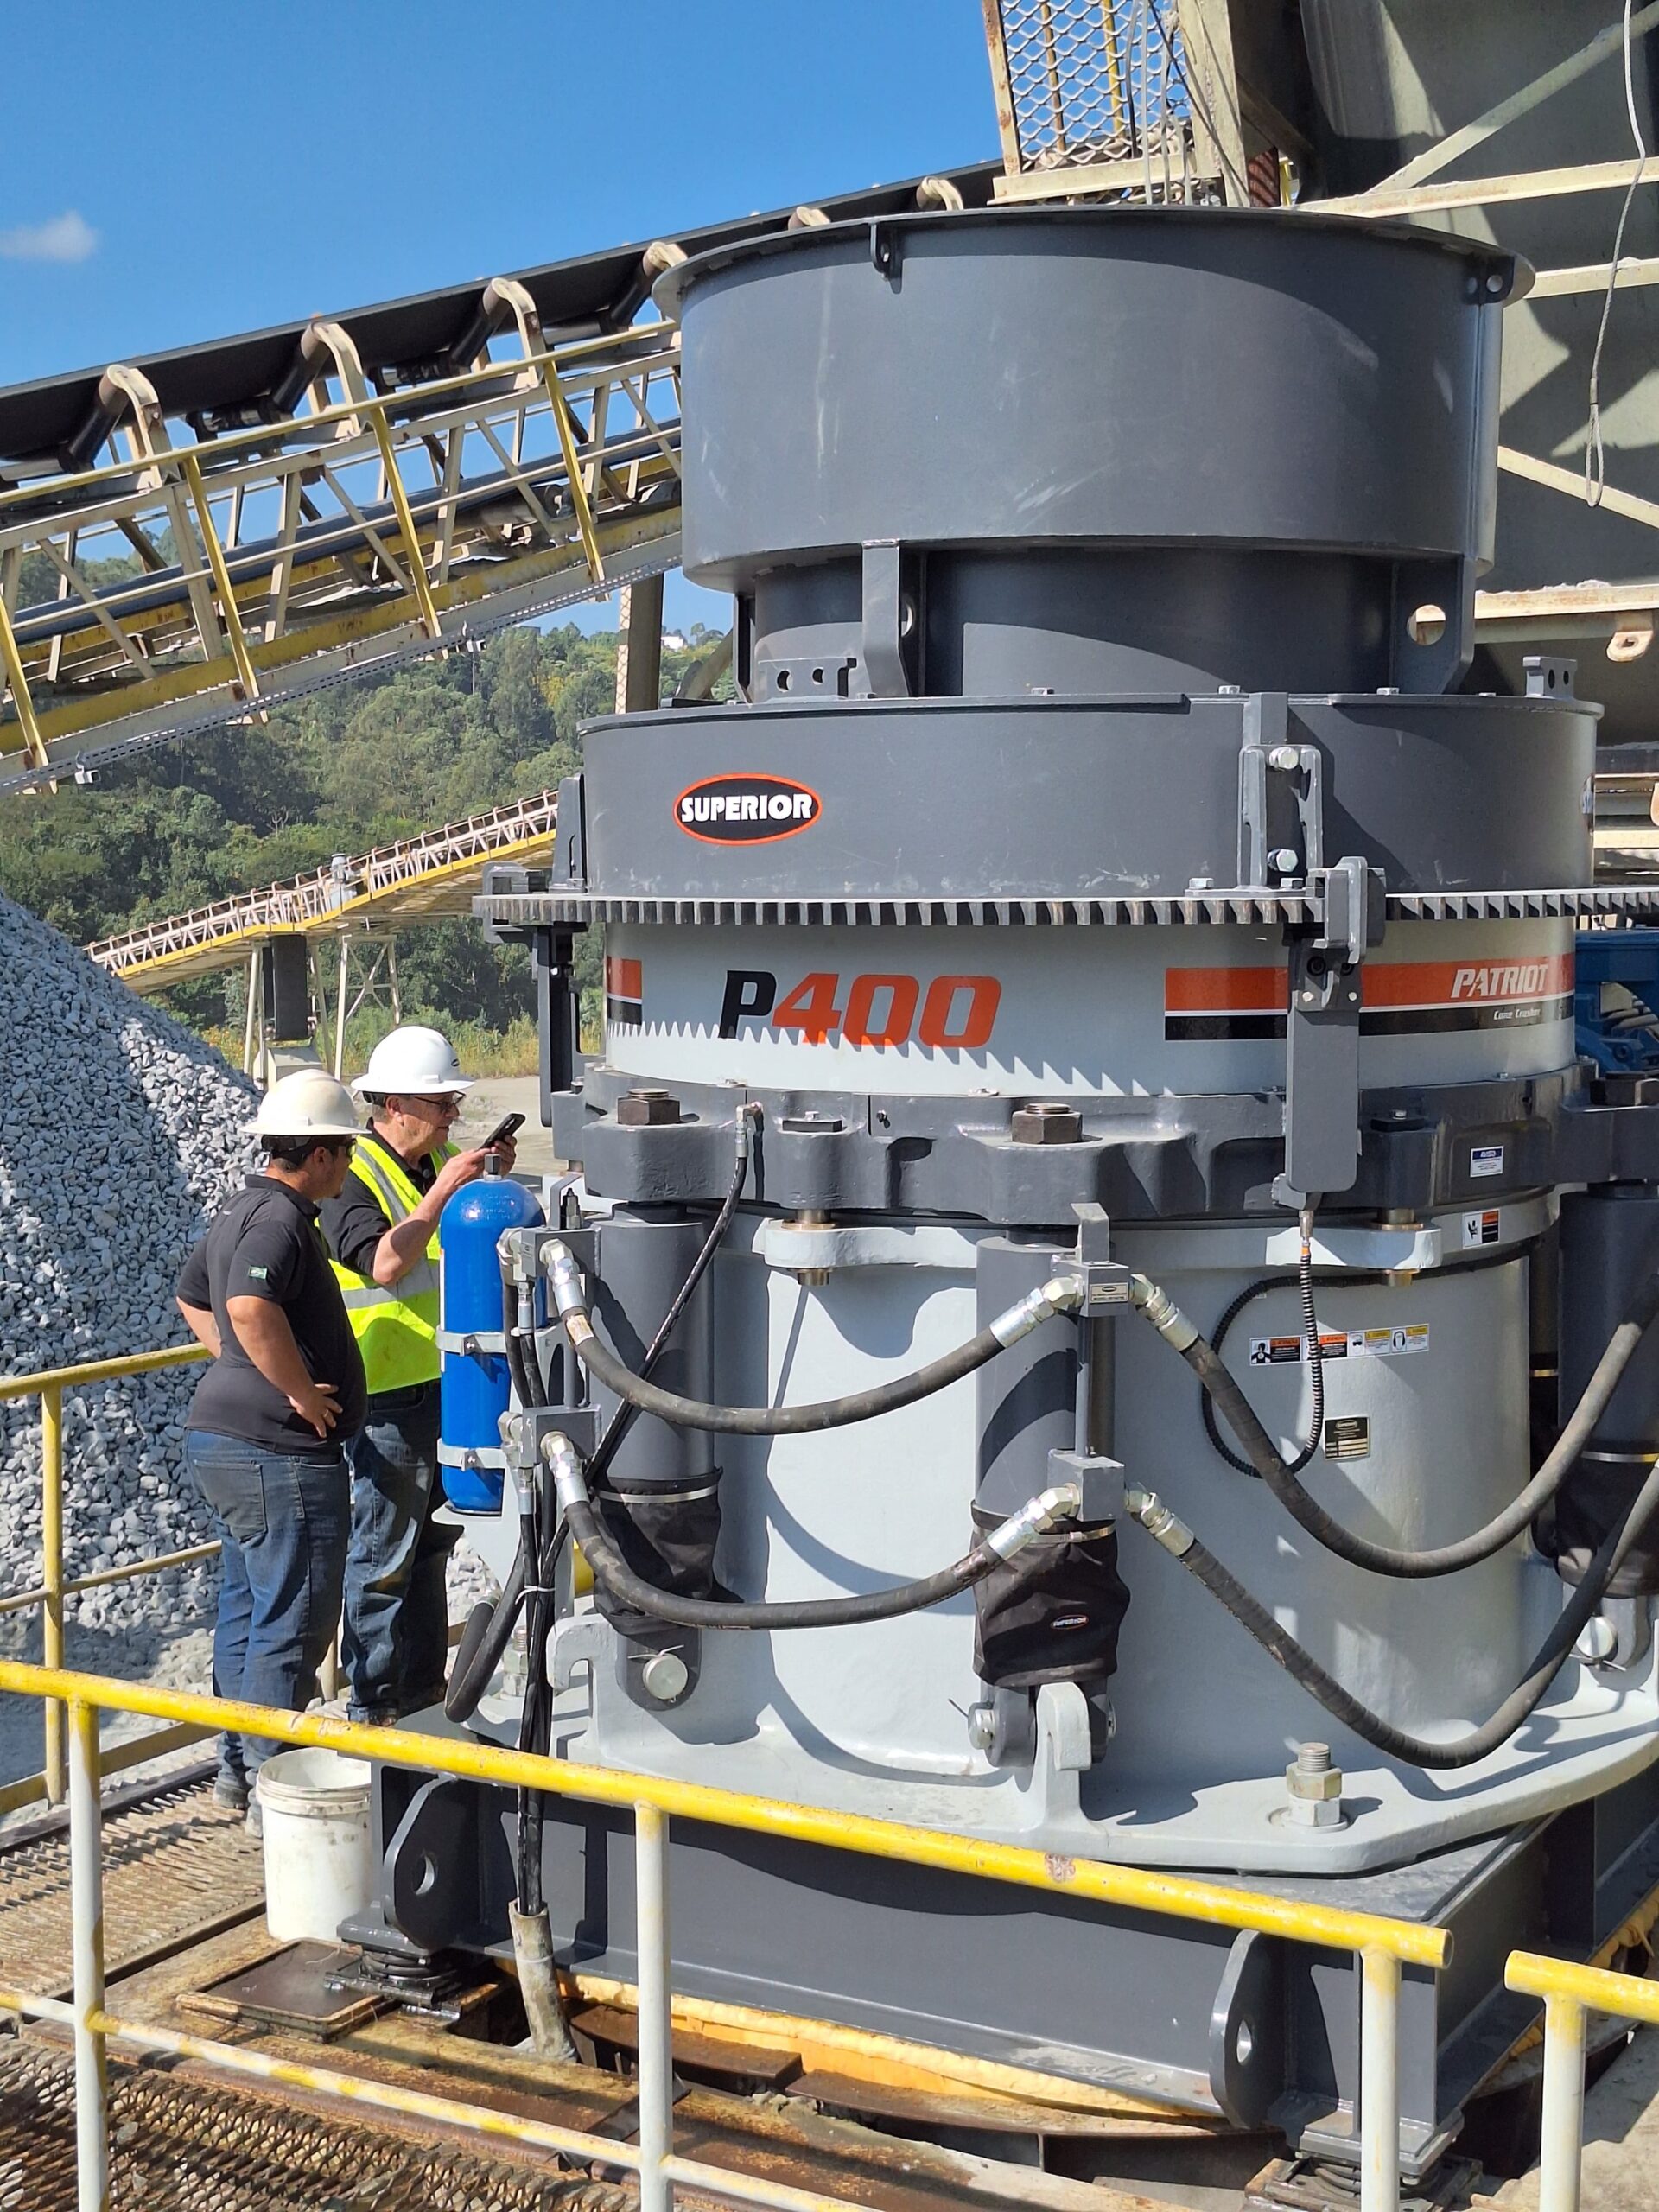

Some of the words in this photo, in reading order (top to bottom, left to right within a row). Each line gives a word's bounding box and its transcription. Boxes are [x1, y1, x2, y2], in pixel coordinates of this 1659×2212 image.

[681, 794, 813, 823] SUPERIOR
[1451, 964, 1548, 998] PATRIOT
[717, 969, 1002, 1048] P400
[1493, 1010, 1513, 1020] Cone
